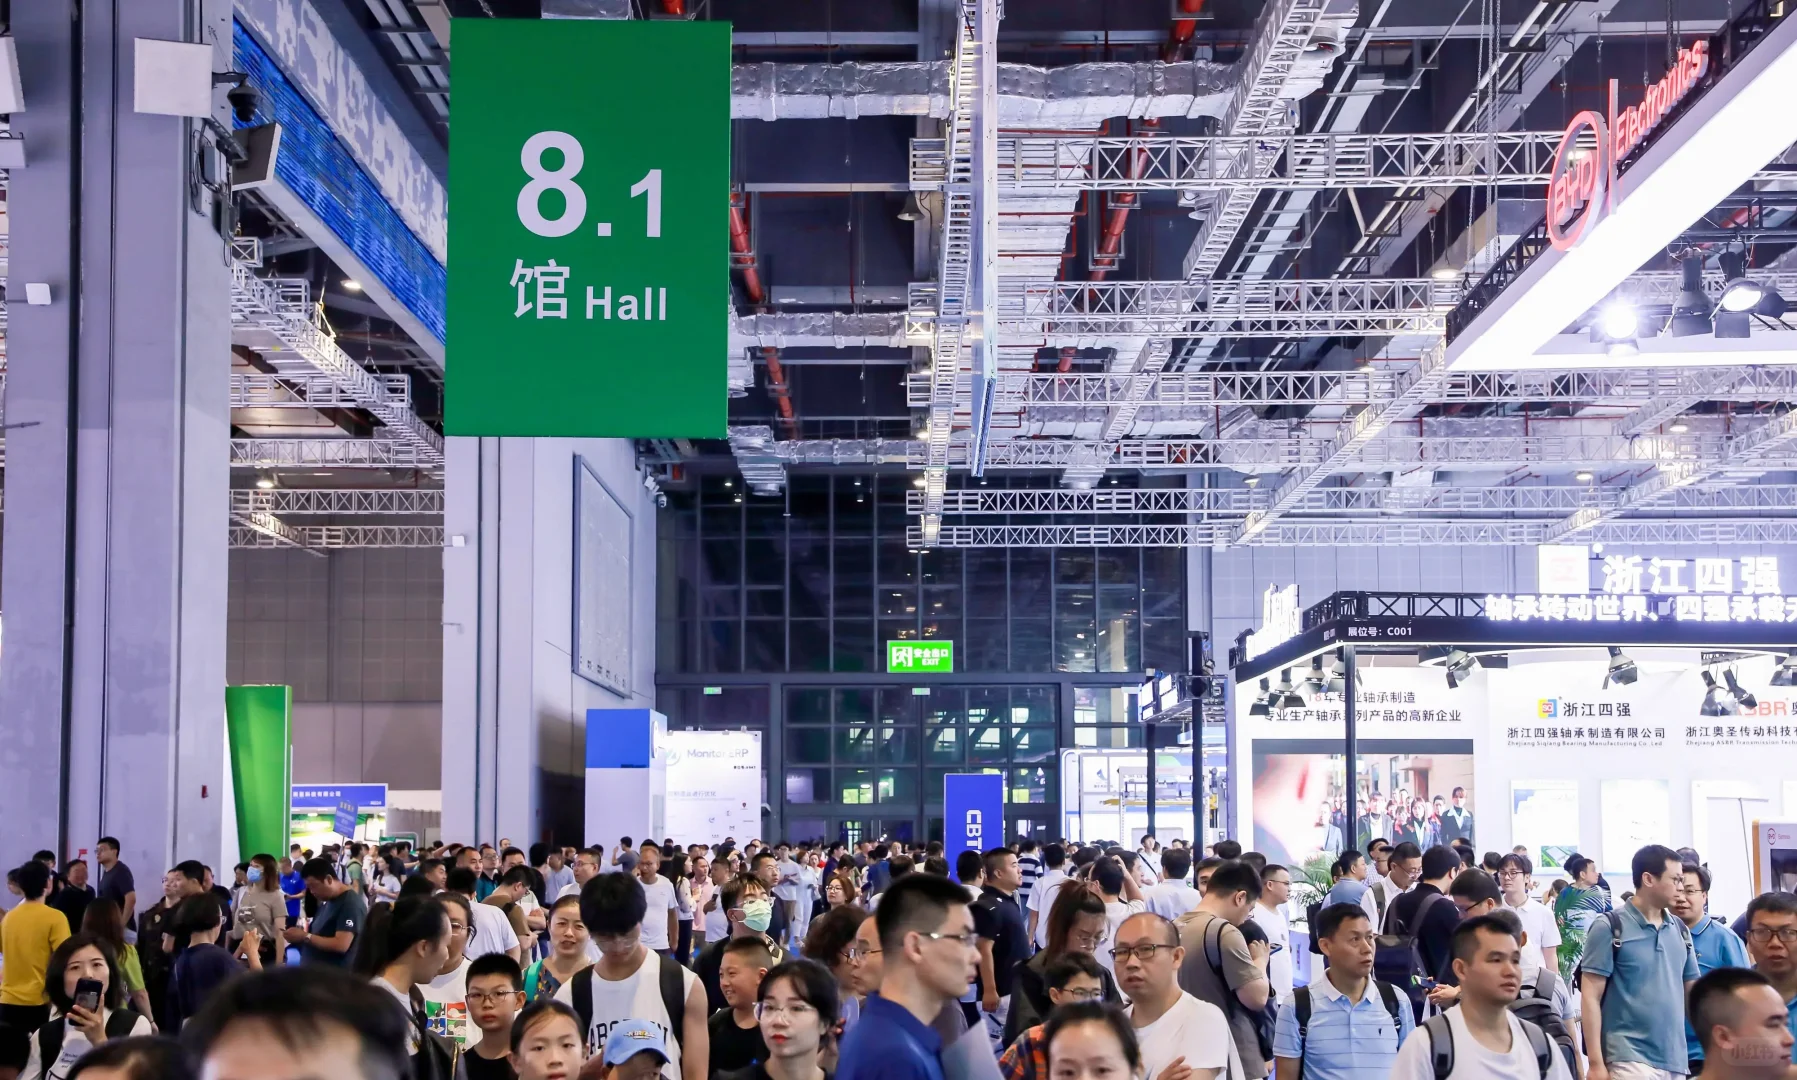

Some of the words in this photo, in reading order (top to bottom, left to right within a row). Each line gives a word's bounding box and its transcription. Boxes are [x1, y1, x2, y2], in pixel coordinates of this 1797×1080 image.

[1615, 40, 1707, 161] Electronics
[516, 130, 662, 238] 8.1
[1554, 151, 1596, 226] BYD
[509, 258, 570, 319] 馆
[585, 285, 667, 320] Hall
[1601, 555, 1781, 595] 浙江四强
[913, 648, 949, 658] 安全出口
[921, 658, 940, 666] EXIT
[1264, 709, 1462, 722] 专业生产轴承列产品的高新企业
[1563, 702, 1631, 717] 浙江四强
[1738, 701, 1788, 716] SBR
[1507, 727, 1666, 739] 浙江四强轴承制造有限公司
[687, 749, 726, 758] Monitor
[966, 809, 983, 855] CBT
